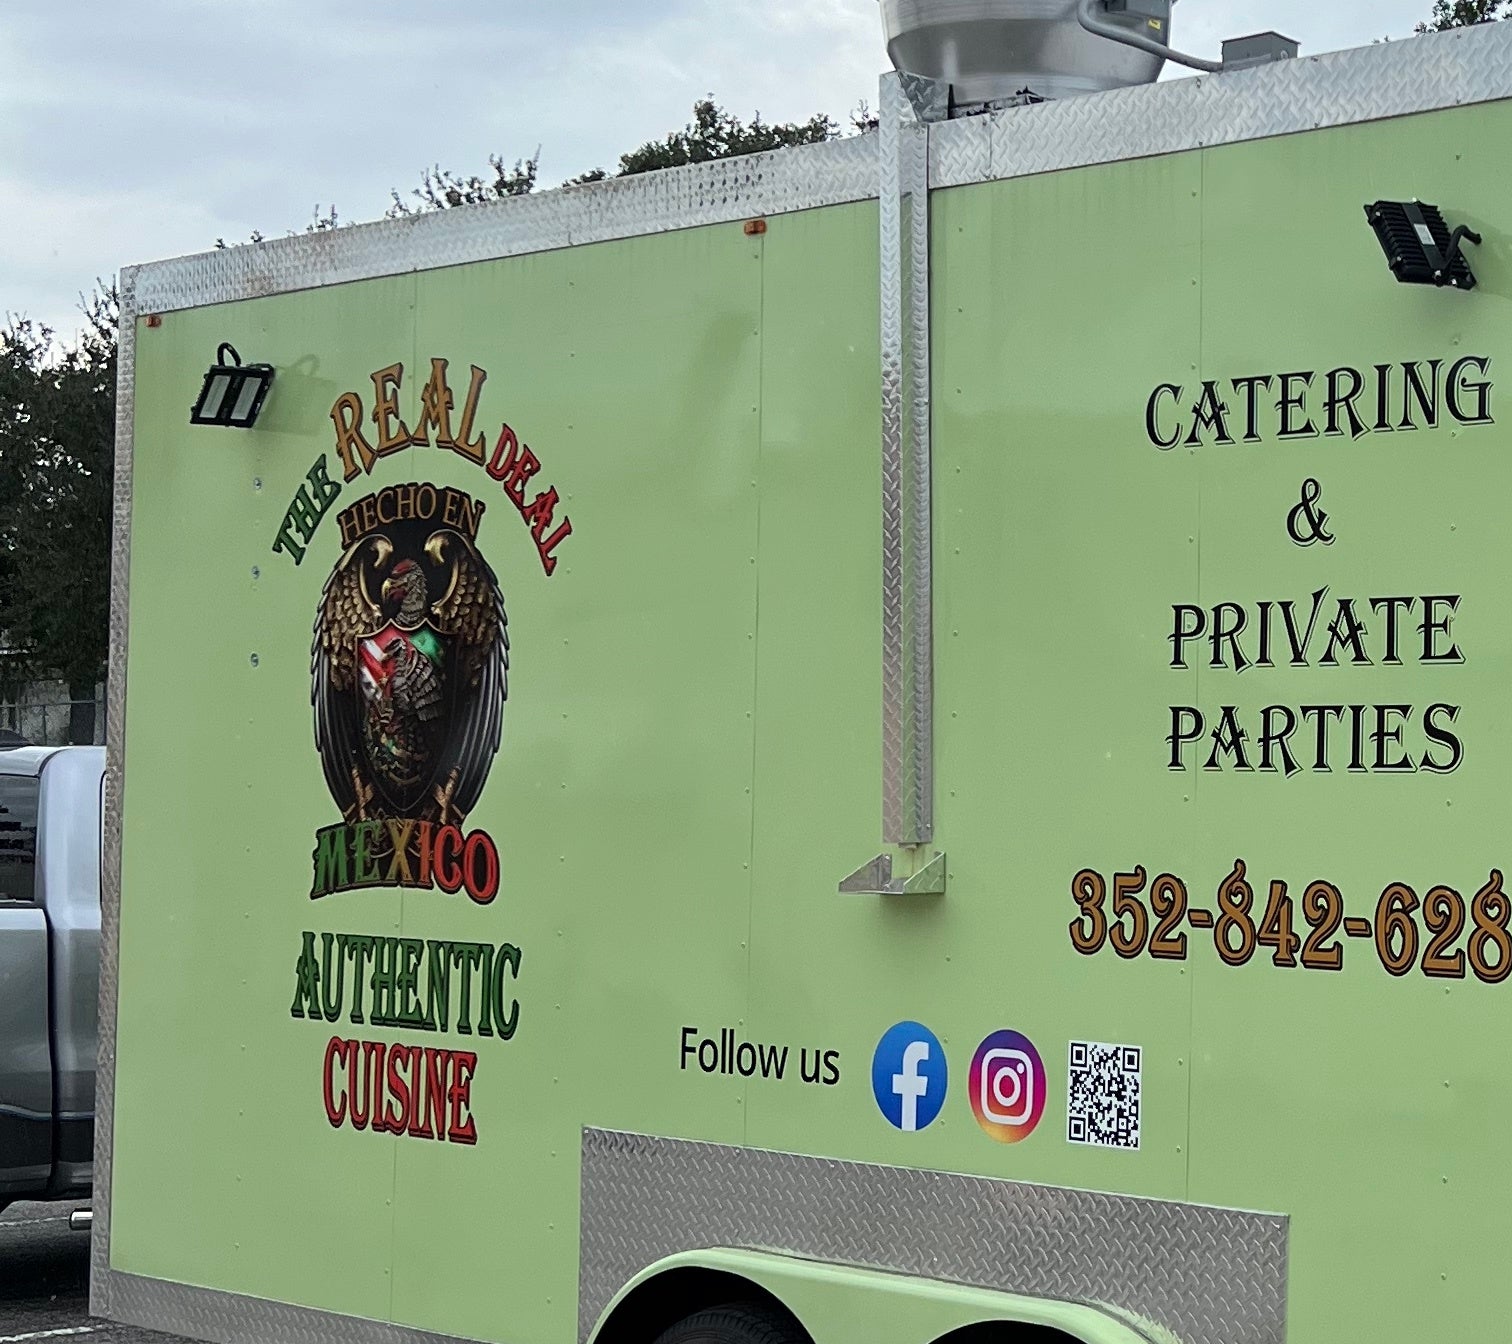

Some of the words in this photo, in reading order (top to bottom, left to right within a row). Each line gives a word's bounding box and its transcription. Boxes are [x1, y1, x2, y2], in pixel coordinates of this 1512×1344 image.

[1145, 356, 1495, 449] CATERING
[273, 454, 342, 566] THE
[330, 358, 486, 483] REAL
[486, 423, 572, 576] DEAL
[340, 486, 437, 546] HECHO
[442, 491, 484, 541] EN
[1286, 478, 1335, 546] &
[1167, 586, 1466, 672] PRIVATE
[1165, 704, 1464, 776] PARTIES
[310, 818, 500, 905] MEXICO
[291, 931, 522, 1040] AUTHENTIC
[323, 1035, 478, 1145] CUISINE
[680, 1027, 788, 1080] Follow
[801, 1048, 840, 1085] us
